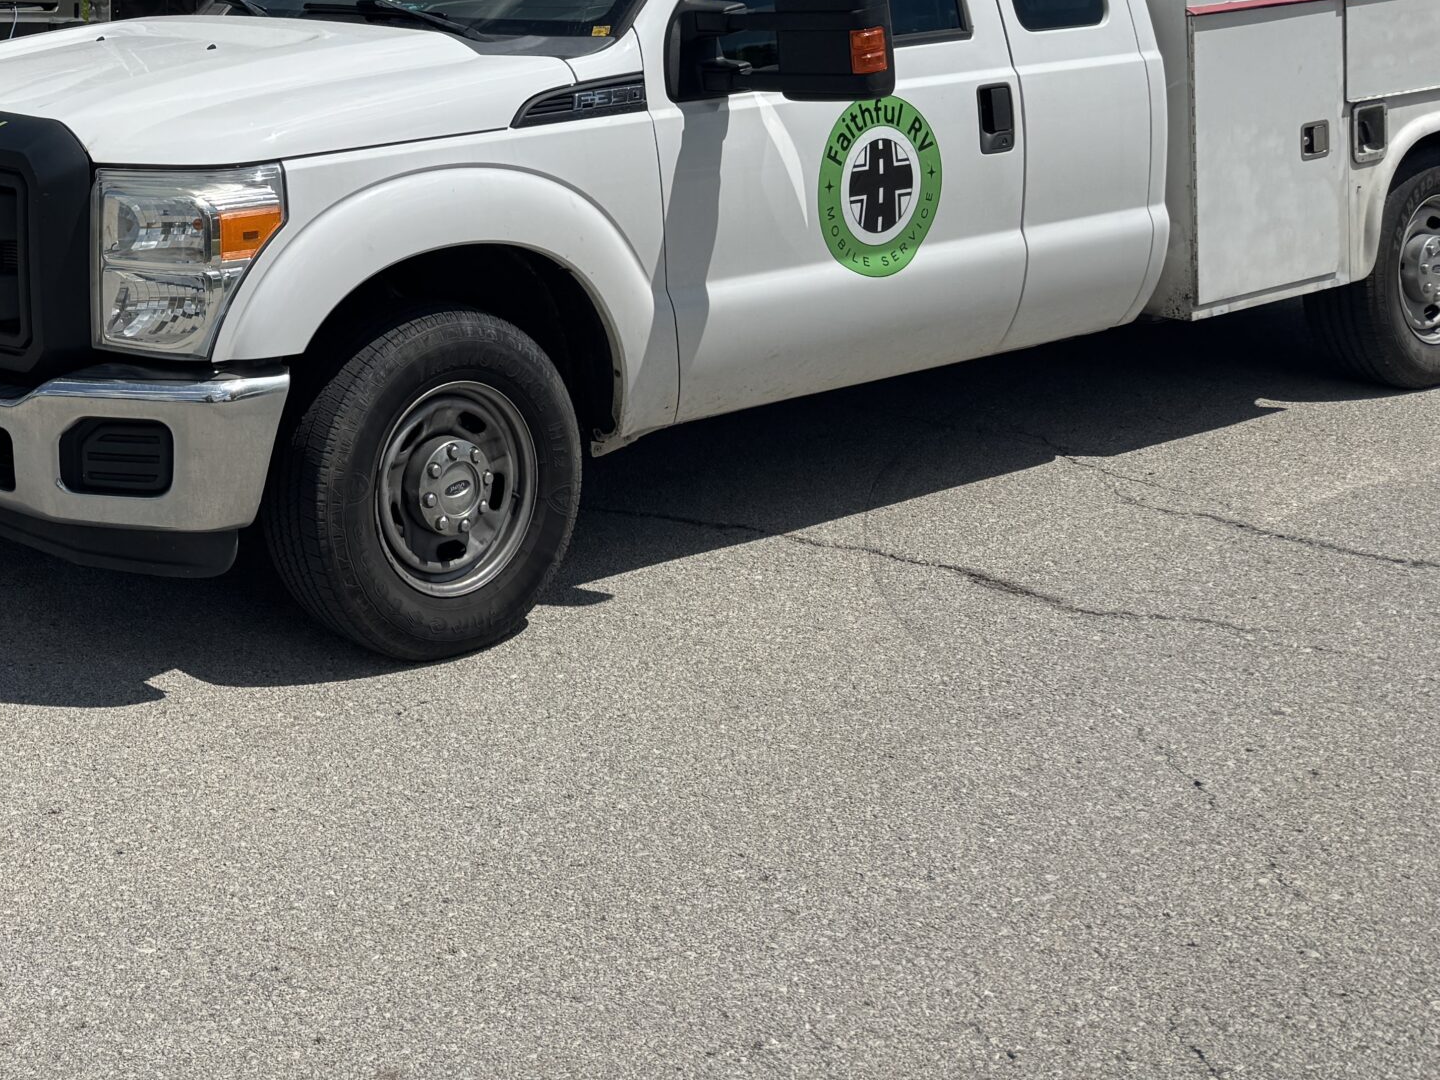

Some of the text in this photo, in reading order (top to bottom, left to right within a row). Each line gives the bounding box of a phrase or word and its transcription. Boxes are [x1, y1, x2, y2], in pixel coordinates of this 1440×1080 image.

[826, 99, 934, 167] Faithful RV
[826, 192, 934, 267] MOBILE SERVICE
